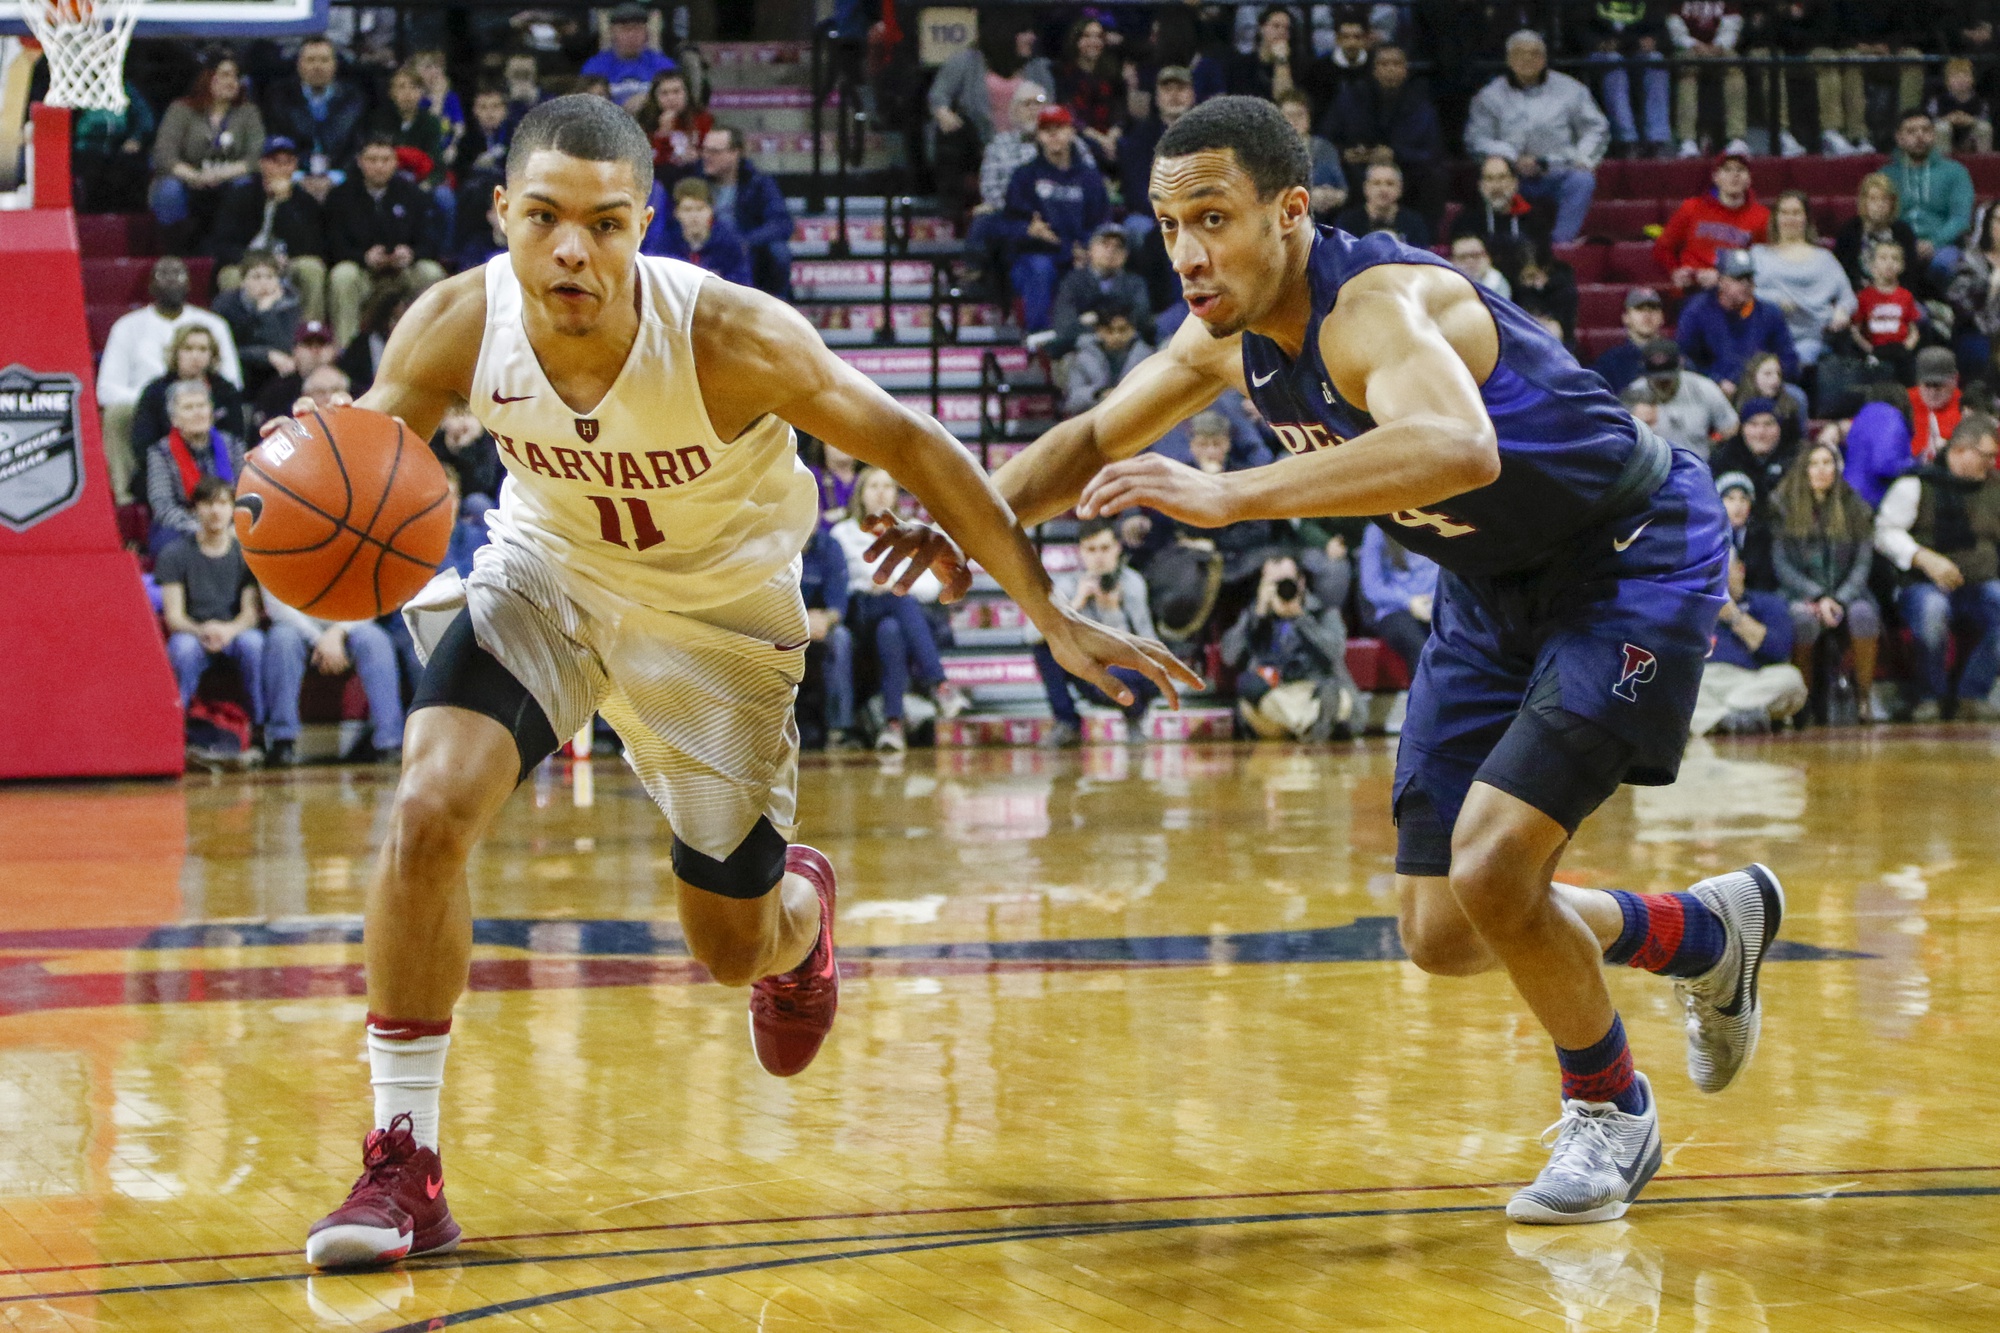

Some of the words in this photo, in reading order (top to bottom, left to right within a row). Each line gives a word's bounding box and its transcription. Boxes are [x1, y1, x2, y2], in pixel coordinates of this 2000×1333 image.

[18, 392, 70, 412] LINE
[580, 423, 594, 436] H
[1267, 420, 1347, 455] PE
[488, 427, 712, 490] HARVARD
[583, 495, 666, 552] 11
[1612, 642, 1658, 703] P
